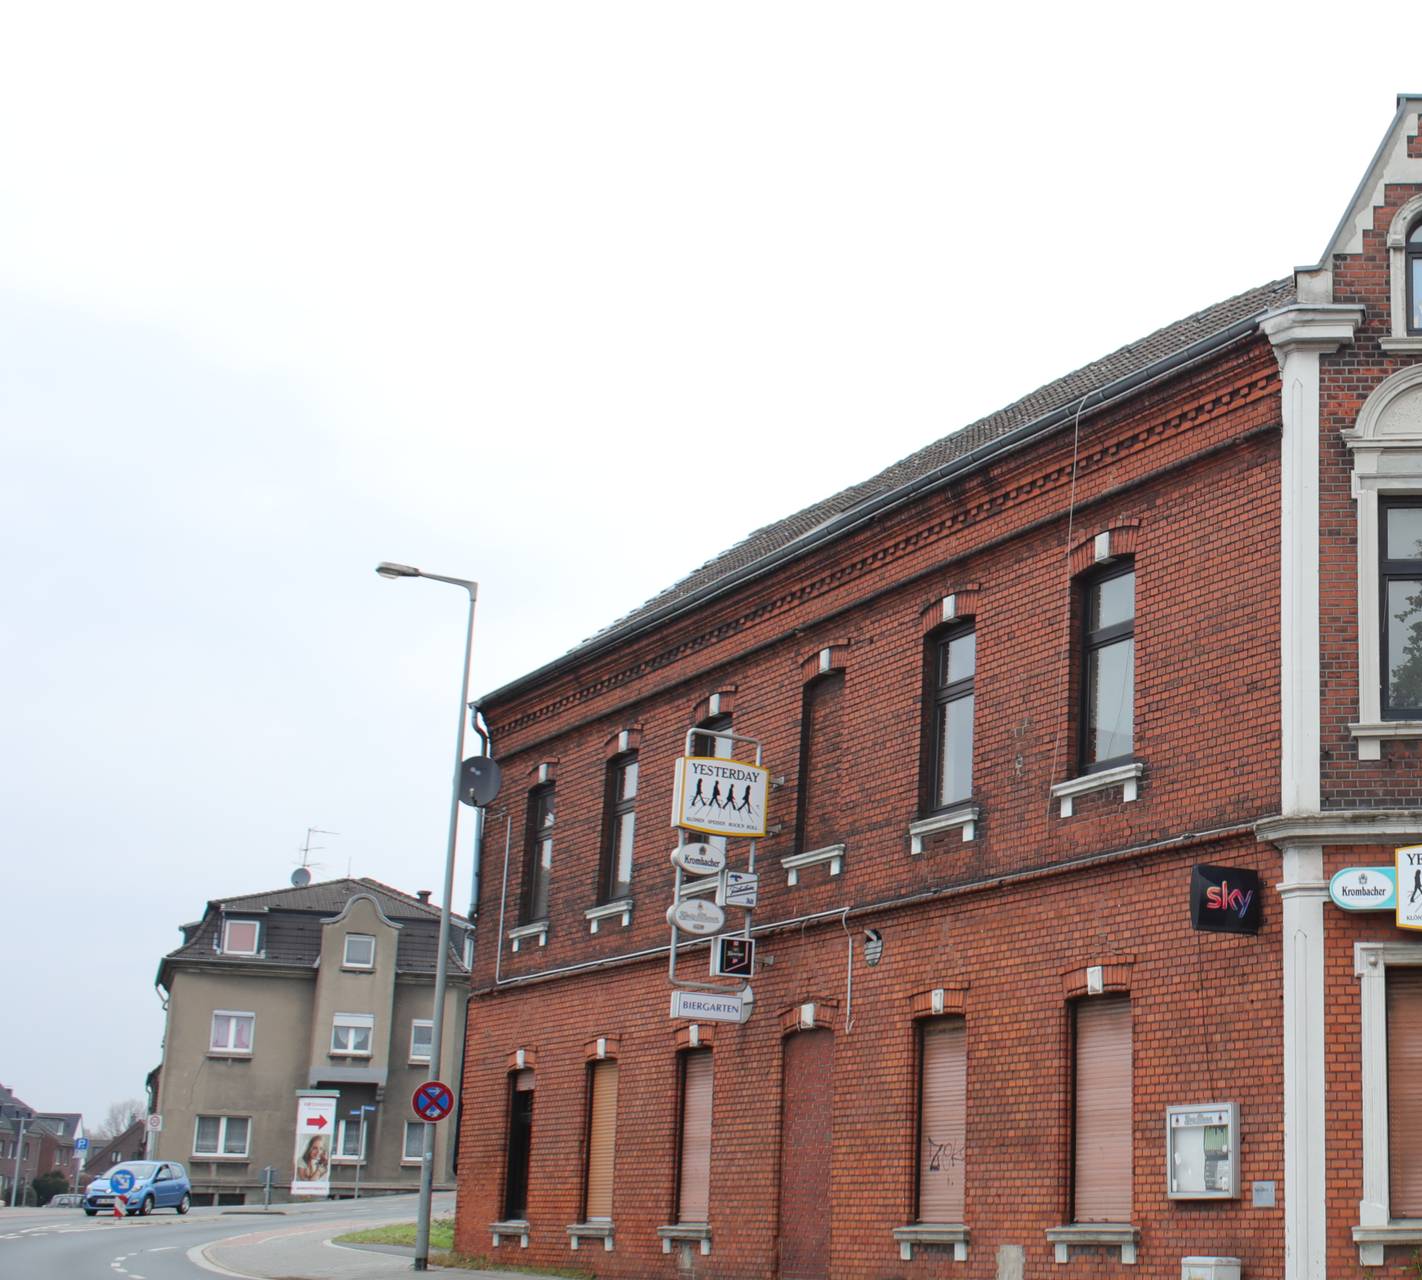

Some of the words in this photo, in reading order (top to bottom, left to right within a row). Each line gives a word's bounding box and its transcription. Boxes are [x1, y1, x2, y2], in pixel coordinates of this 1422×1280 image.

[692, 762, 760, 783] YESTERDAY
[684, 854, 721, 868] Krombacher
[1341, 886, 1386, 897] Krombacher
[1206, 880, 1254, 919] sky
[682, 1000, 740, 1015] BIERGARTEN
